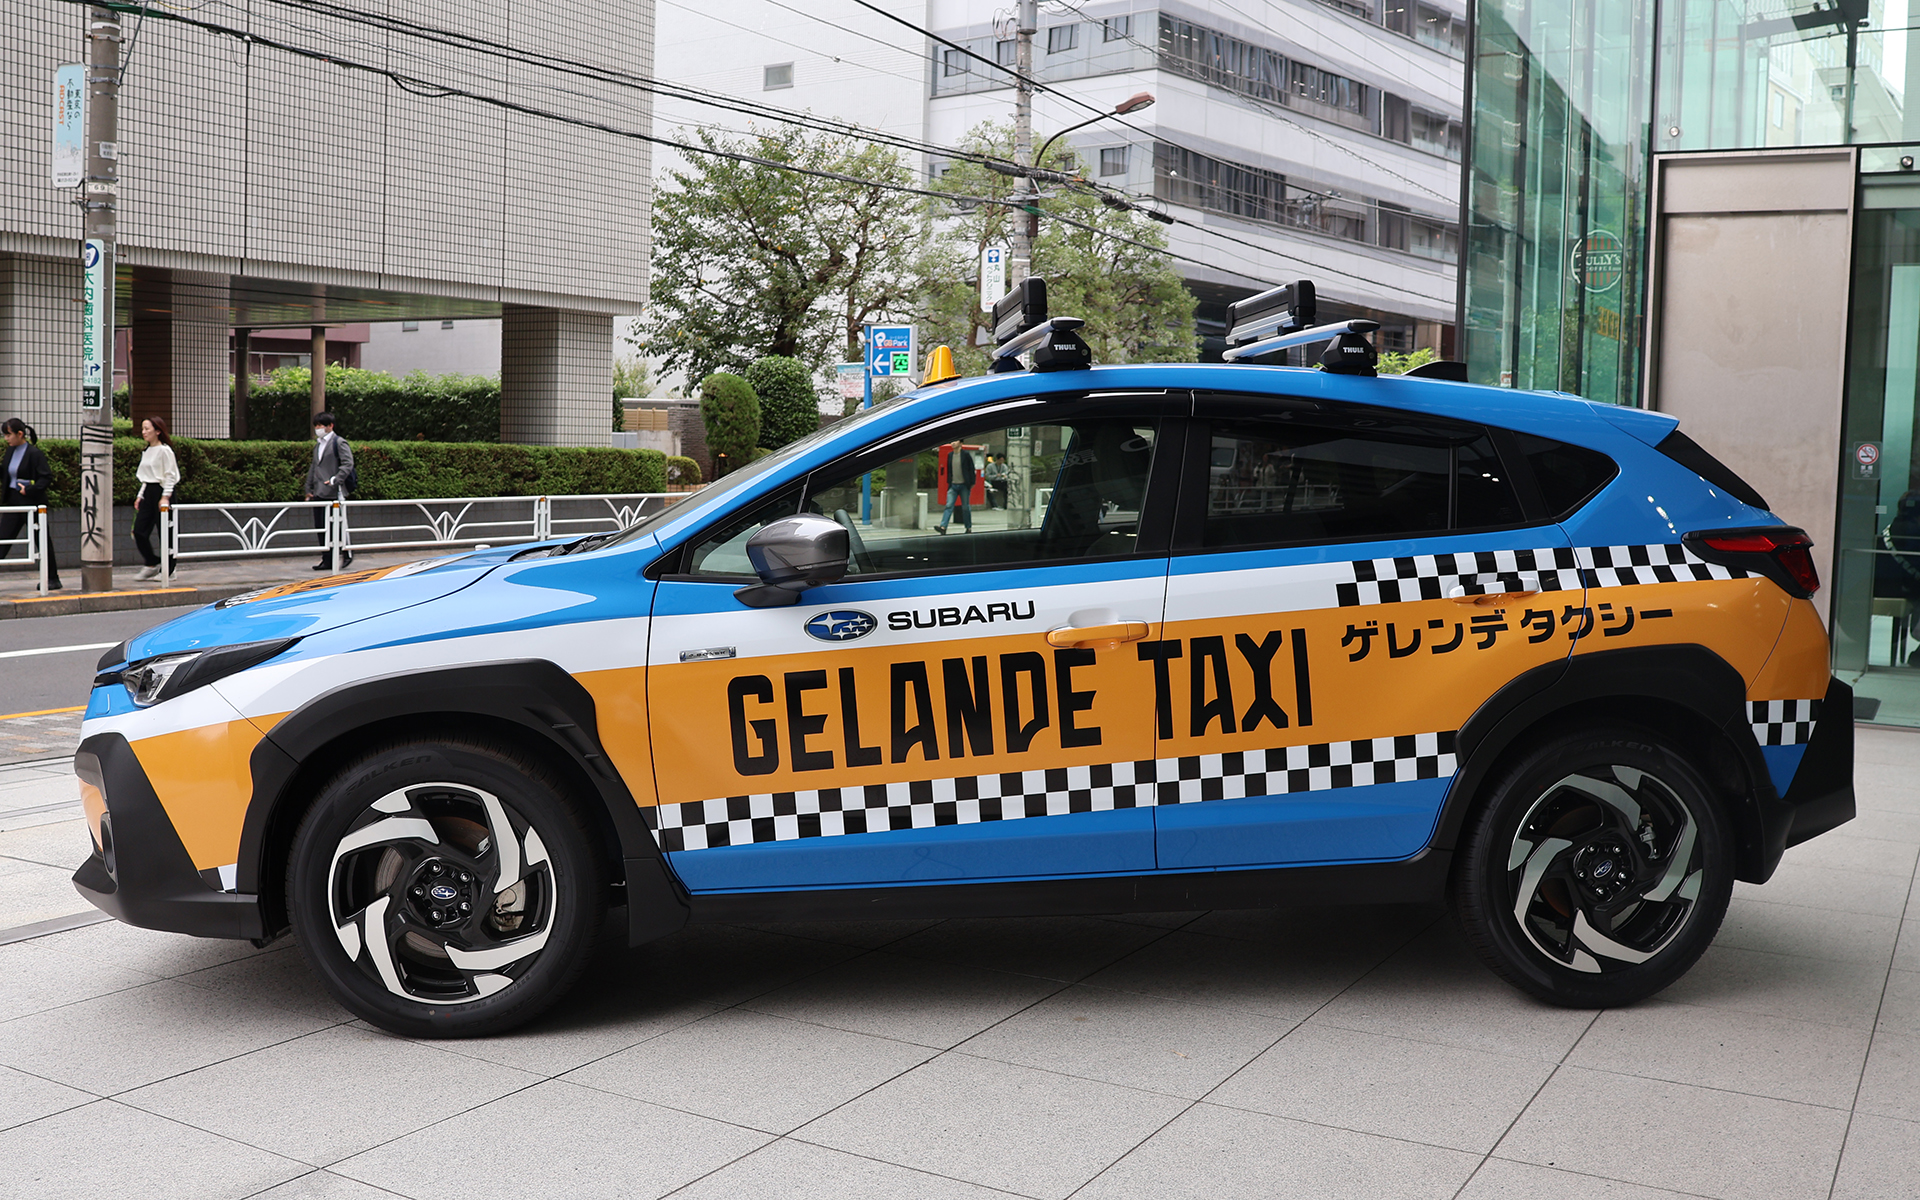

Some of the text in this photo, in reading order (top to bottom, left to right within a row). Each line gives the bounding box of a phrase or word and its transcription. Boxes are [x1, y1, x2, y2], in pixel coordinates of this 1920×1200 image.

[1575, 253, 1622, 266] ULLY'S
[993, 264, 1000, 283] 丸山
[893, 339, 908, 347] Park
[1342, 346, 1365, 354] THULE
[893, 353, 909, 374] 空
[886, 600, 1036, 631] SUBARU
[1341, 603, 1674, 663] ゲレンデ タクシー
[728, 628, 1314, 777] GELANDE TAXI
